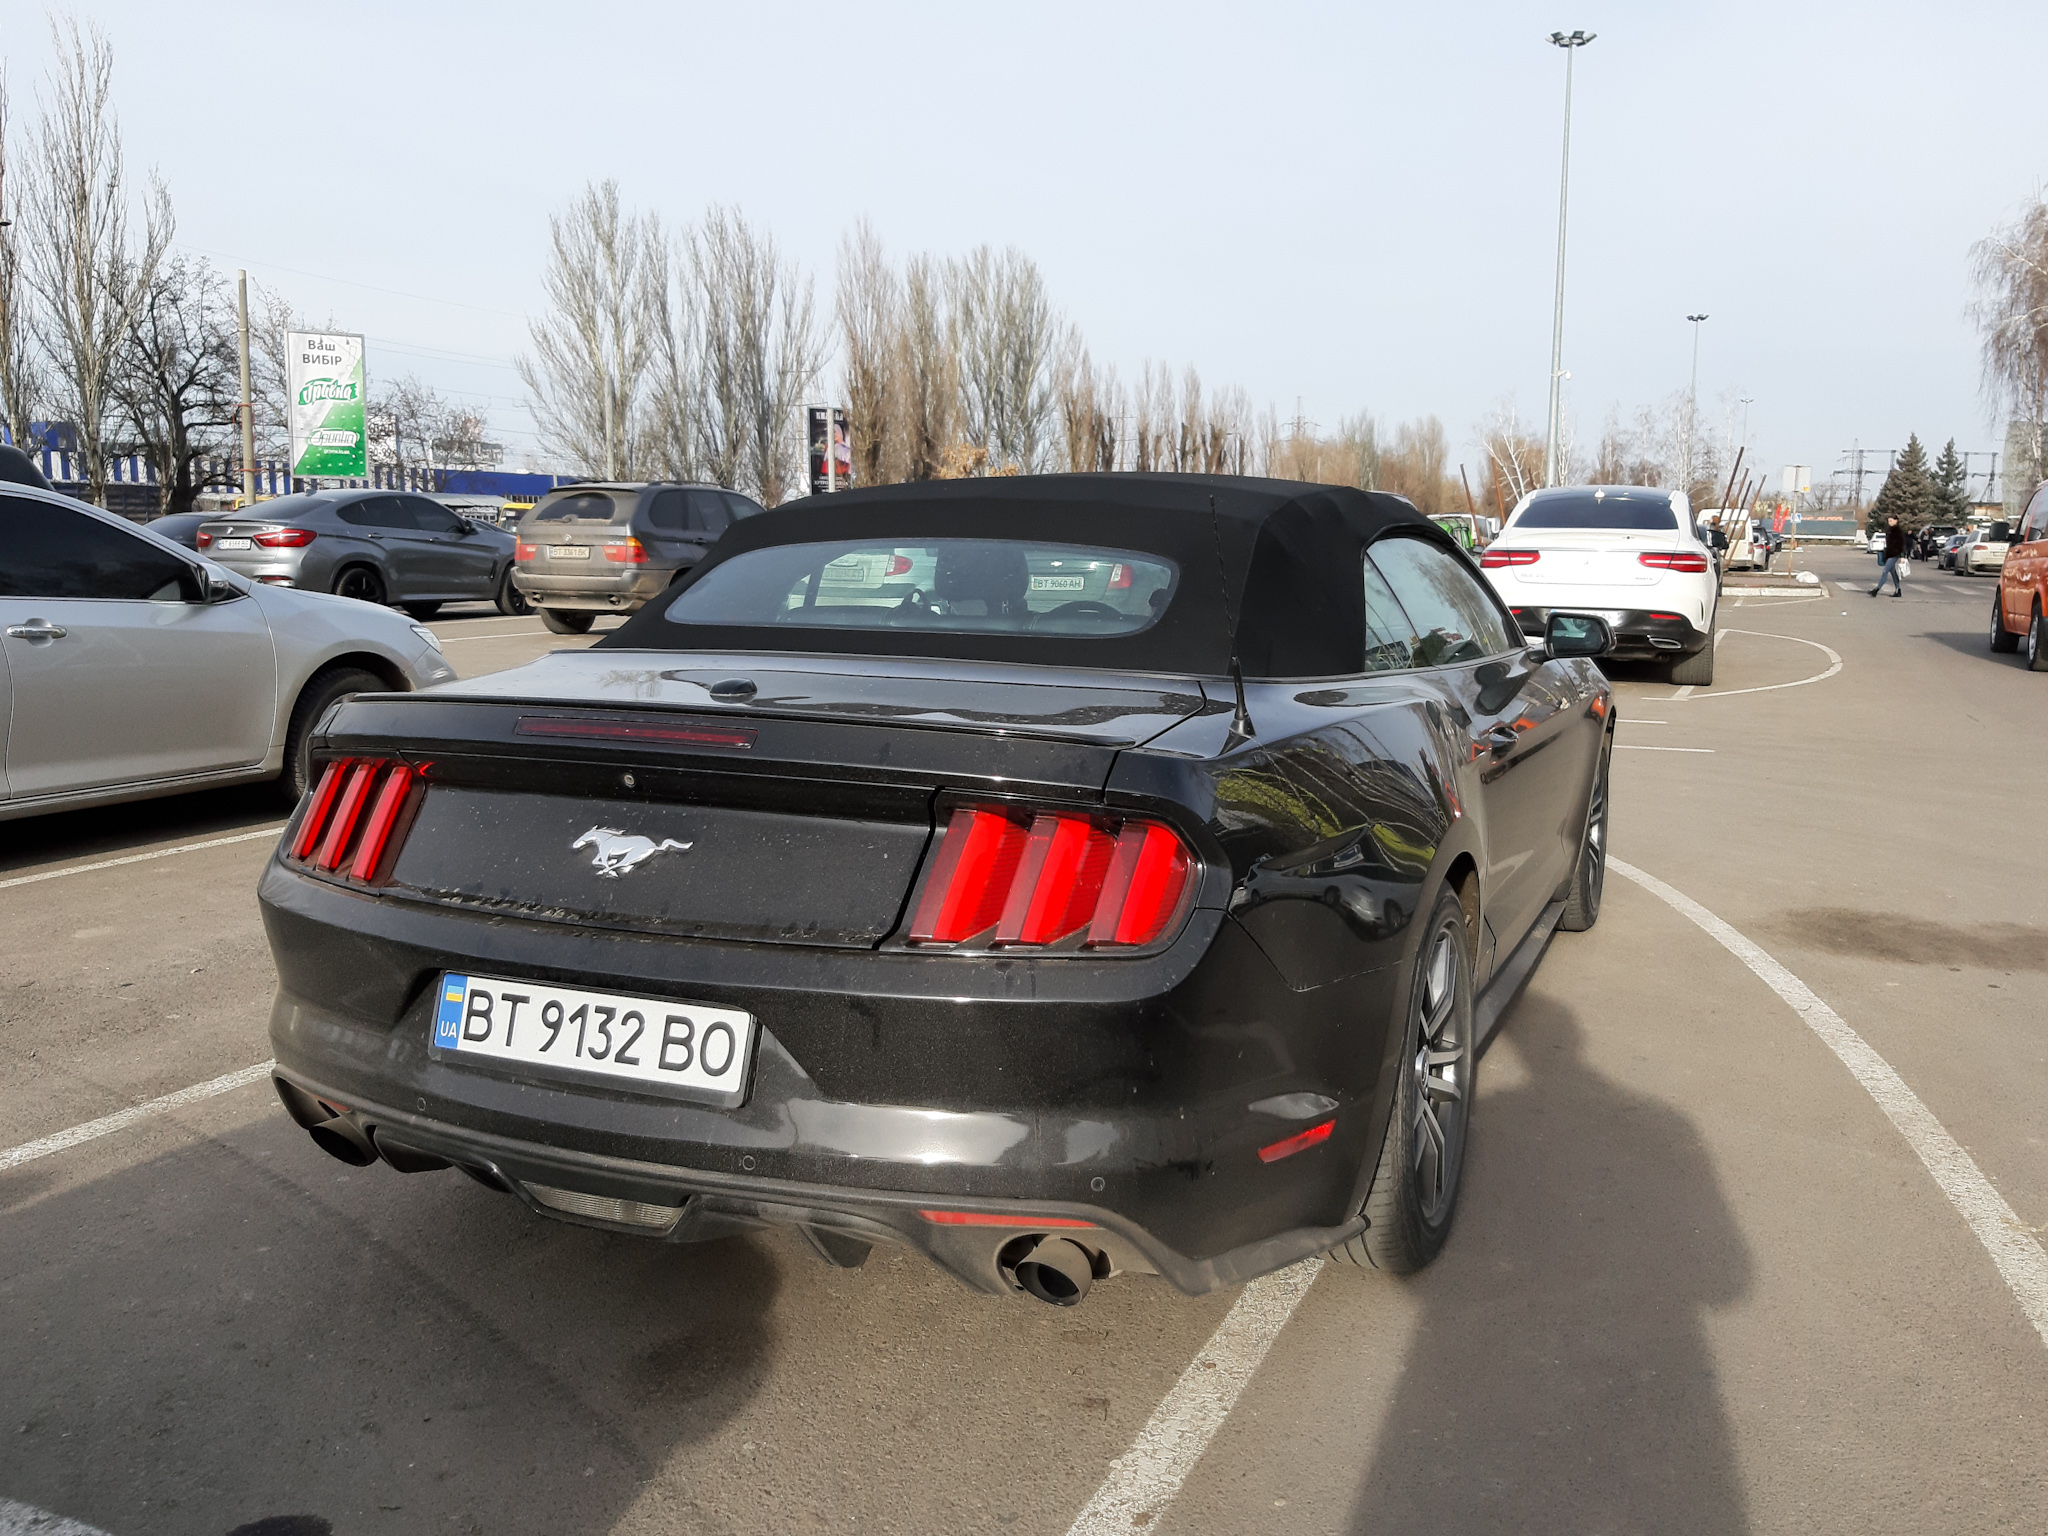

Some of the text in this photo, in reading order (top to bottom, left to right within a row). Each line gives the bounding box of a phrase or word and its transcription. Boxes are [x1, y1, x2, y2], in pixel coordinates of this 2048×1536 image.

[307, 339, 336, 352] Ваш
[302, 353, 343, 366] ВИБІР
[1037, 579, 1049, 588] BT
[1069, 580, 1081, 588] AH
[440, 1021, 457, 1039] UA
[462, 988, 737, 1078] BT 9132 BO
